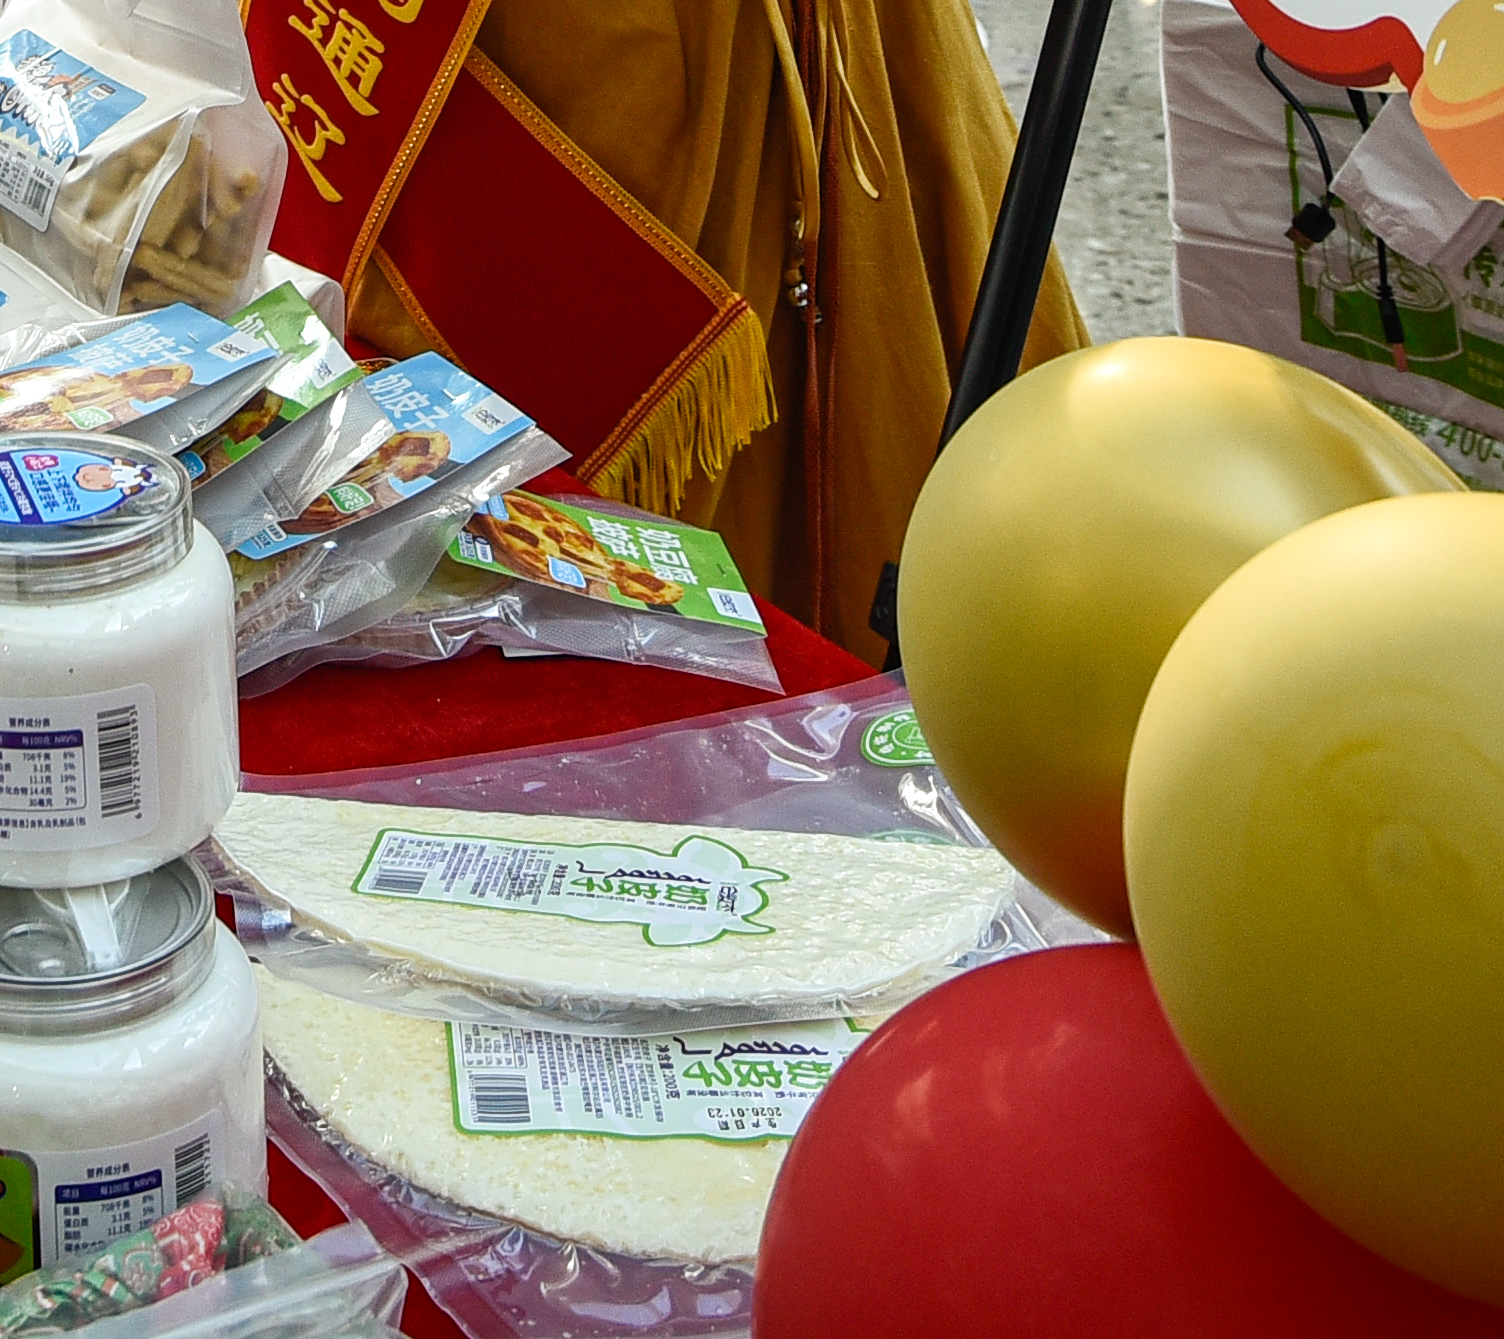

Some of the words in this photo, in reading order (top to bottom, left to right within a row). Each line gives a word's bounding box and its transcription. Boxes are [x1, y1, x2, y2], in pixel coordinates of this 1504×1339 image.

[111, 322, 196, 365] 奶皮子
[365, 371, 451, 431] 奶皮子
[635, 525, 699, 586] 奶豆腐
[9, 717, 51, 728] 营养成分表
[86, 1162, 131, 1180] 营养成分表
[63, 1206, 80, 1216] 能量
[63, 1217, 89, 1229] 蛋白质
